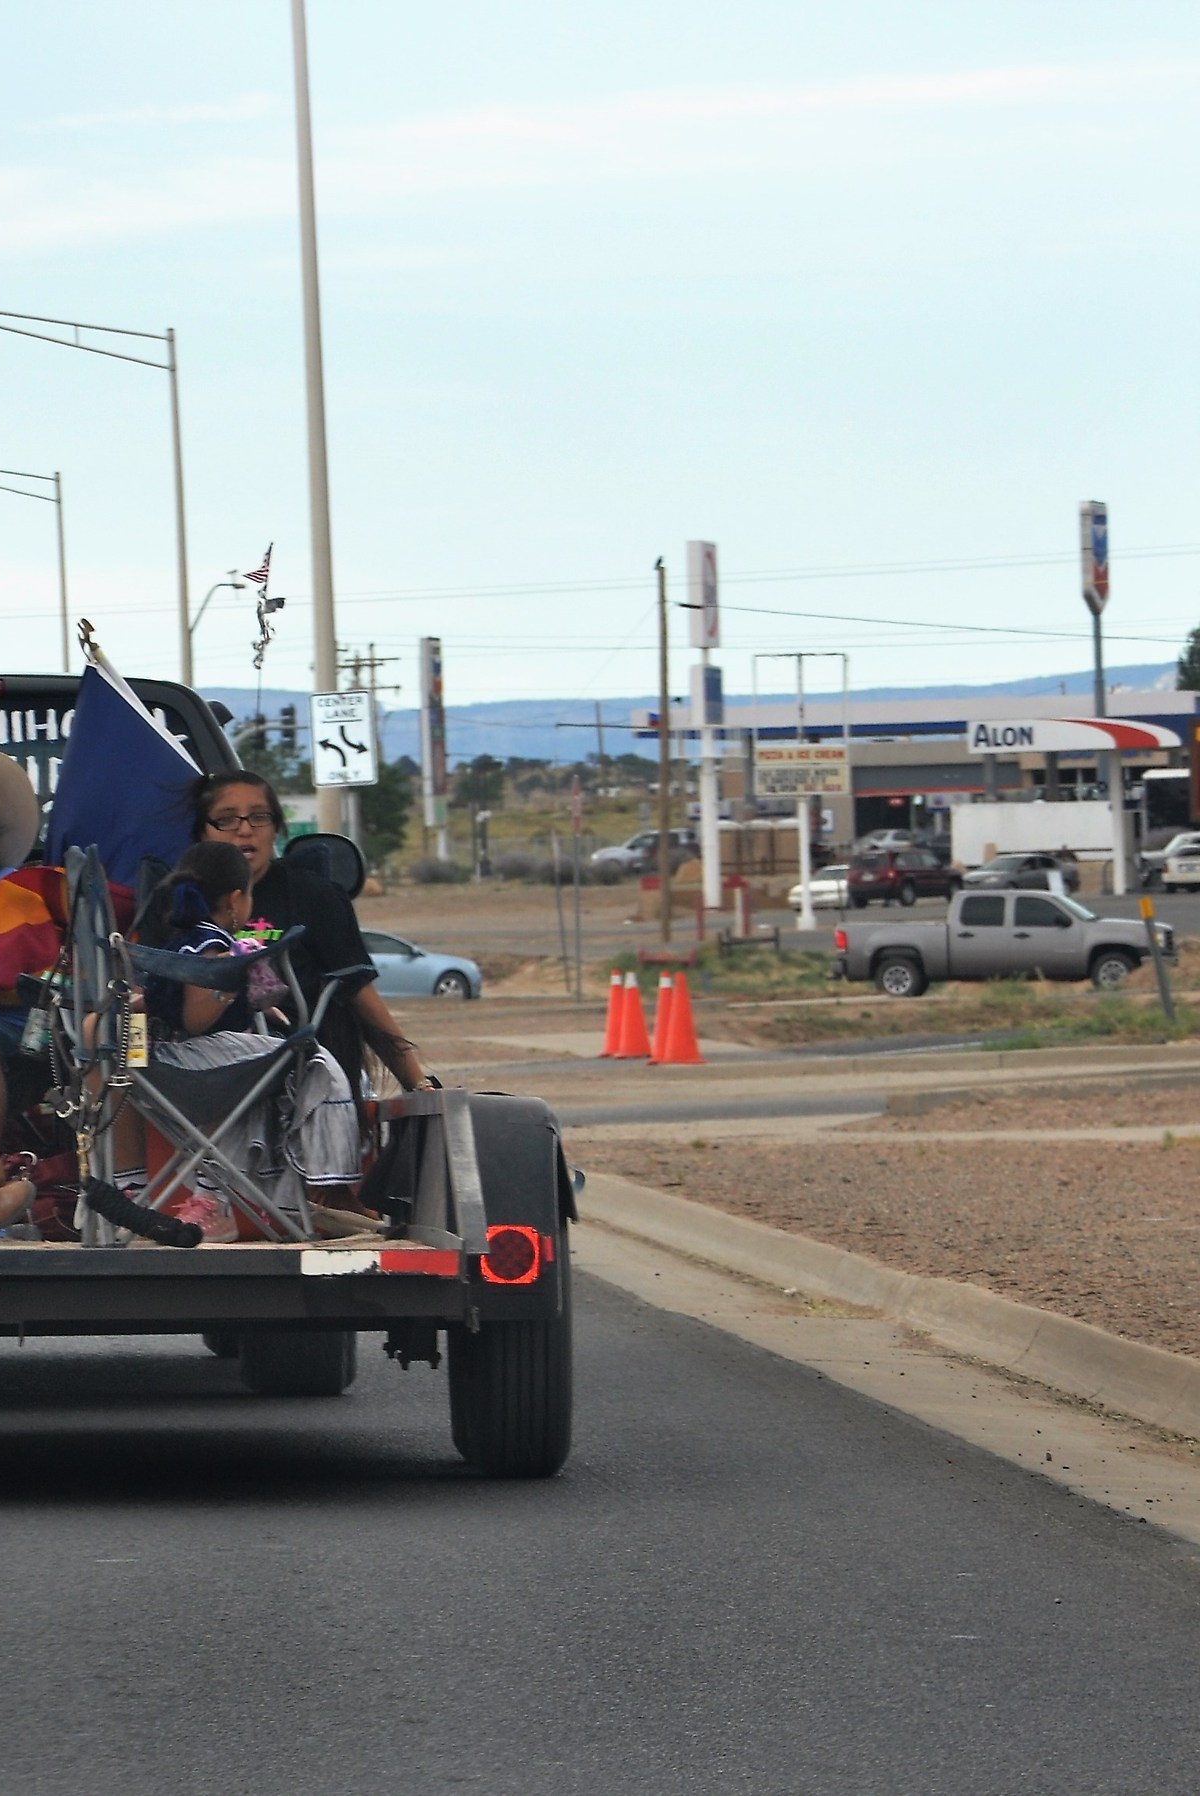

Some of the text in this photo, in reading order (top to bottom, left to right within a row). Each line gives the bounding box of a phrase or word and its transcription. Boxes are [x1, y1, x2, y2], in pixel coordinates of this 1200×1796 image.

[317, 696, 363, 707] CENTER
[325, 708, 356, 719] LANE
[974, 723, 1033, 747] ALON
